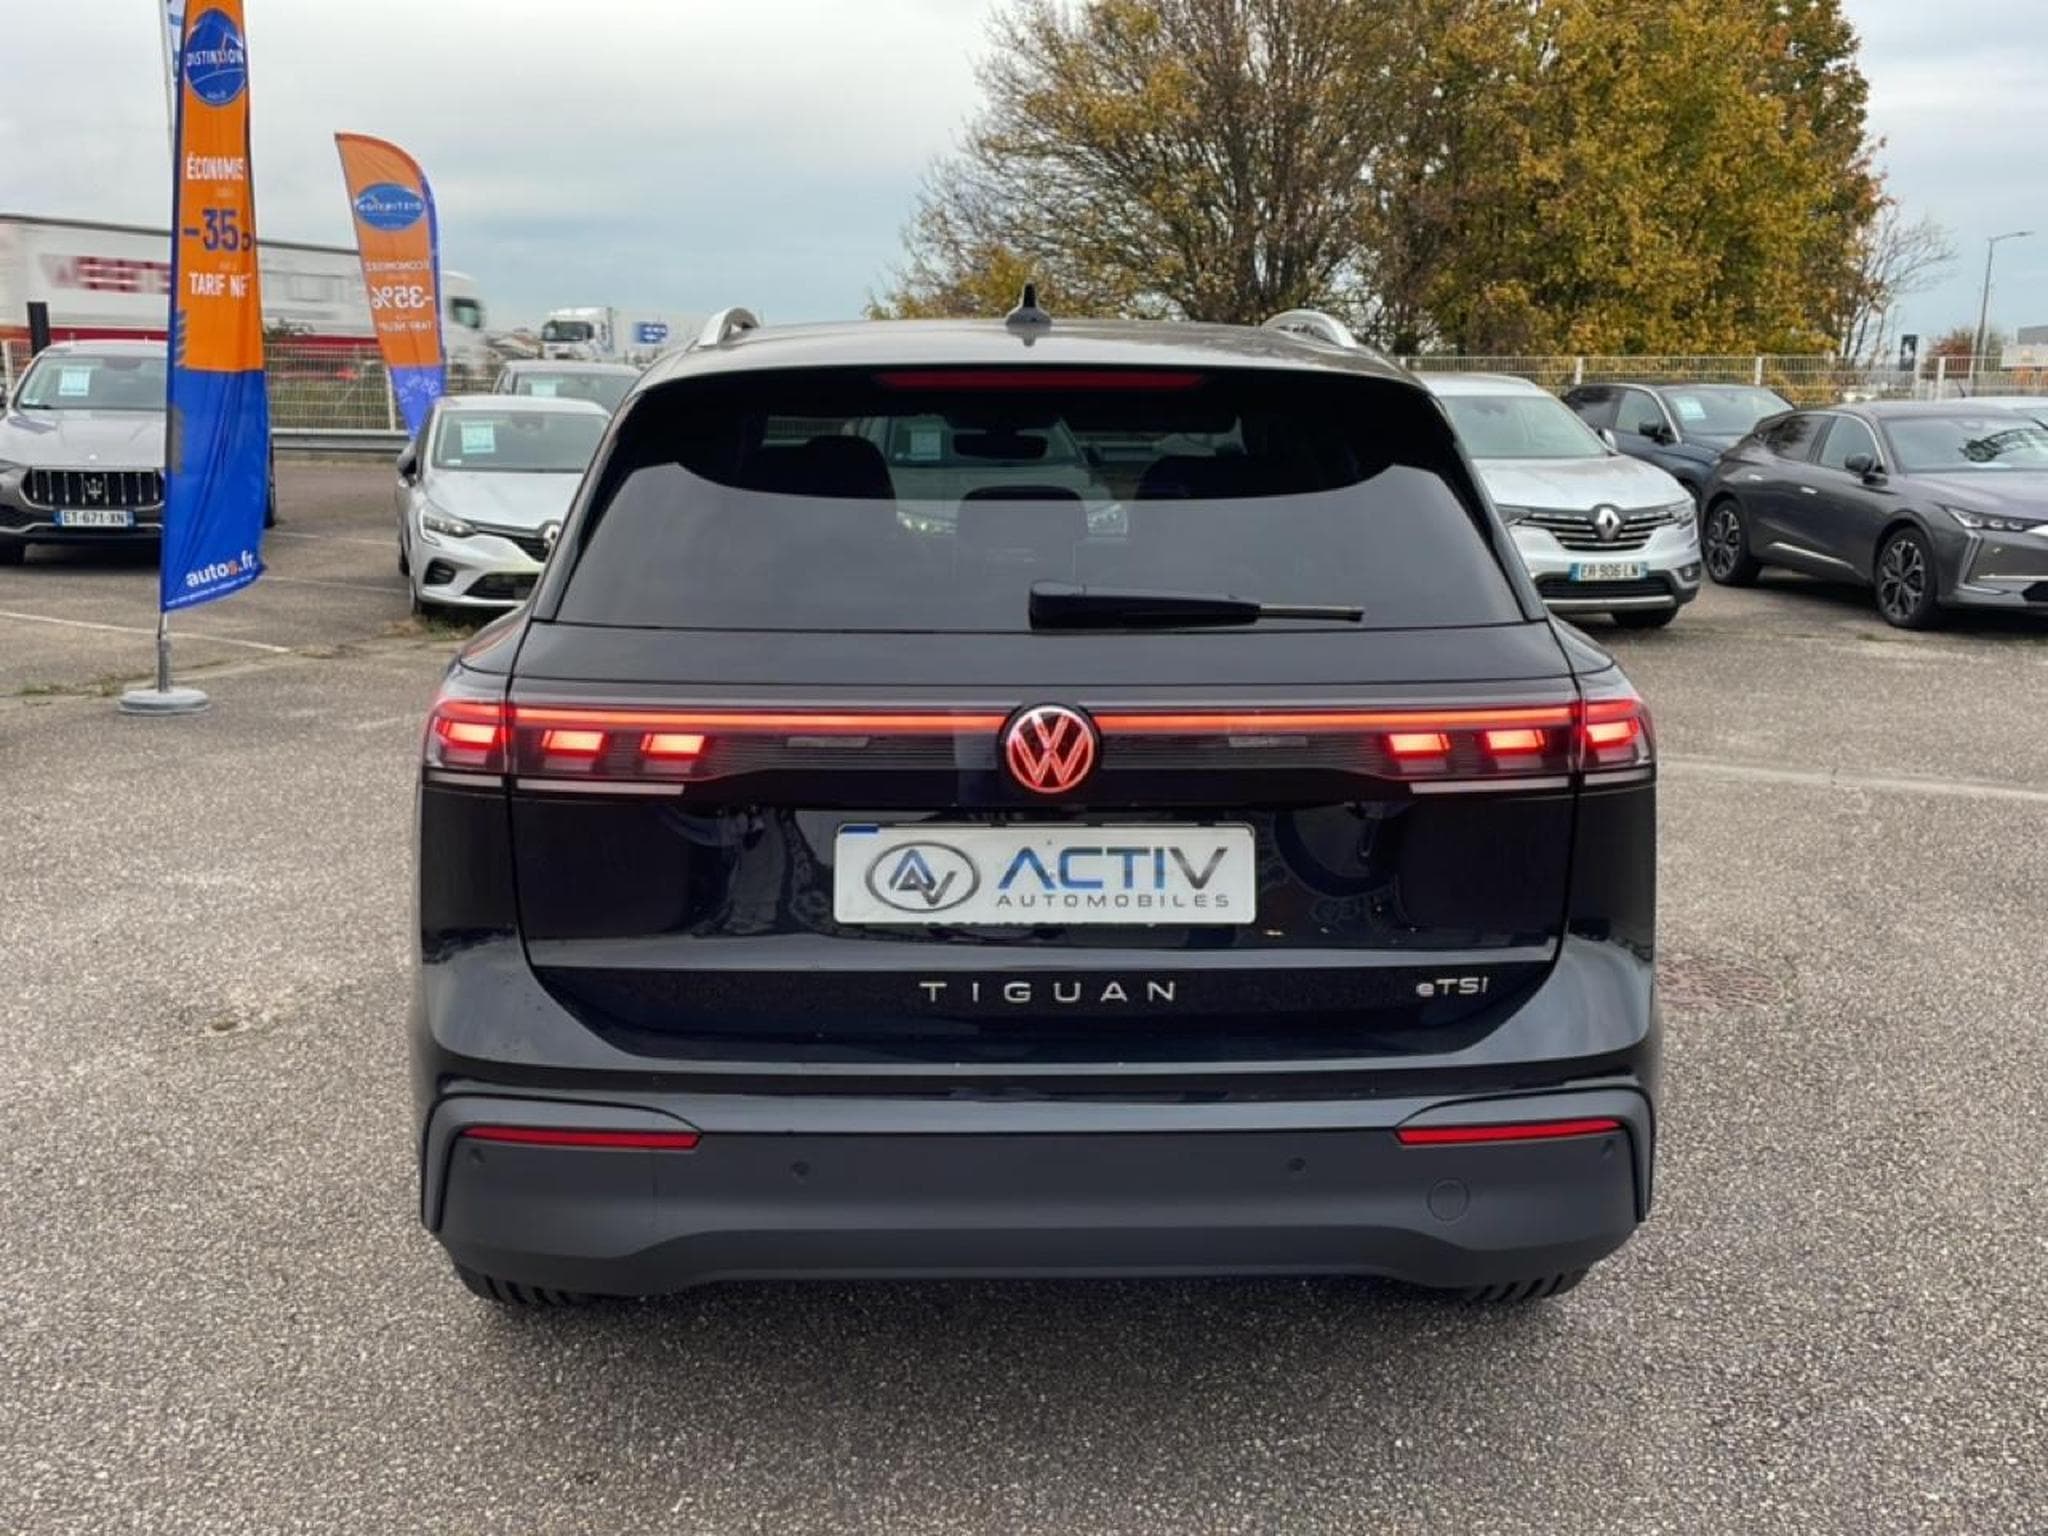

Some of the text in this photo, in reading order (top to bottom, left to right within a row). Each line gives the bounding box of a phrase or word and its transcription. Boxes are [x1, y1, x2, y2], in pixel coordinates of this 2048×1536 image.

[189, 272, 226, 296] TARIF
[185, 549, 253, 588] autos.fr
[997, 846, 1229, 890] ACTIV
[996, 893, 1231, 909] AUTOMOBILES
[918, 981, 1176, 1003] TIGUAN
[1415, 976, 1489, 997] eTSI
